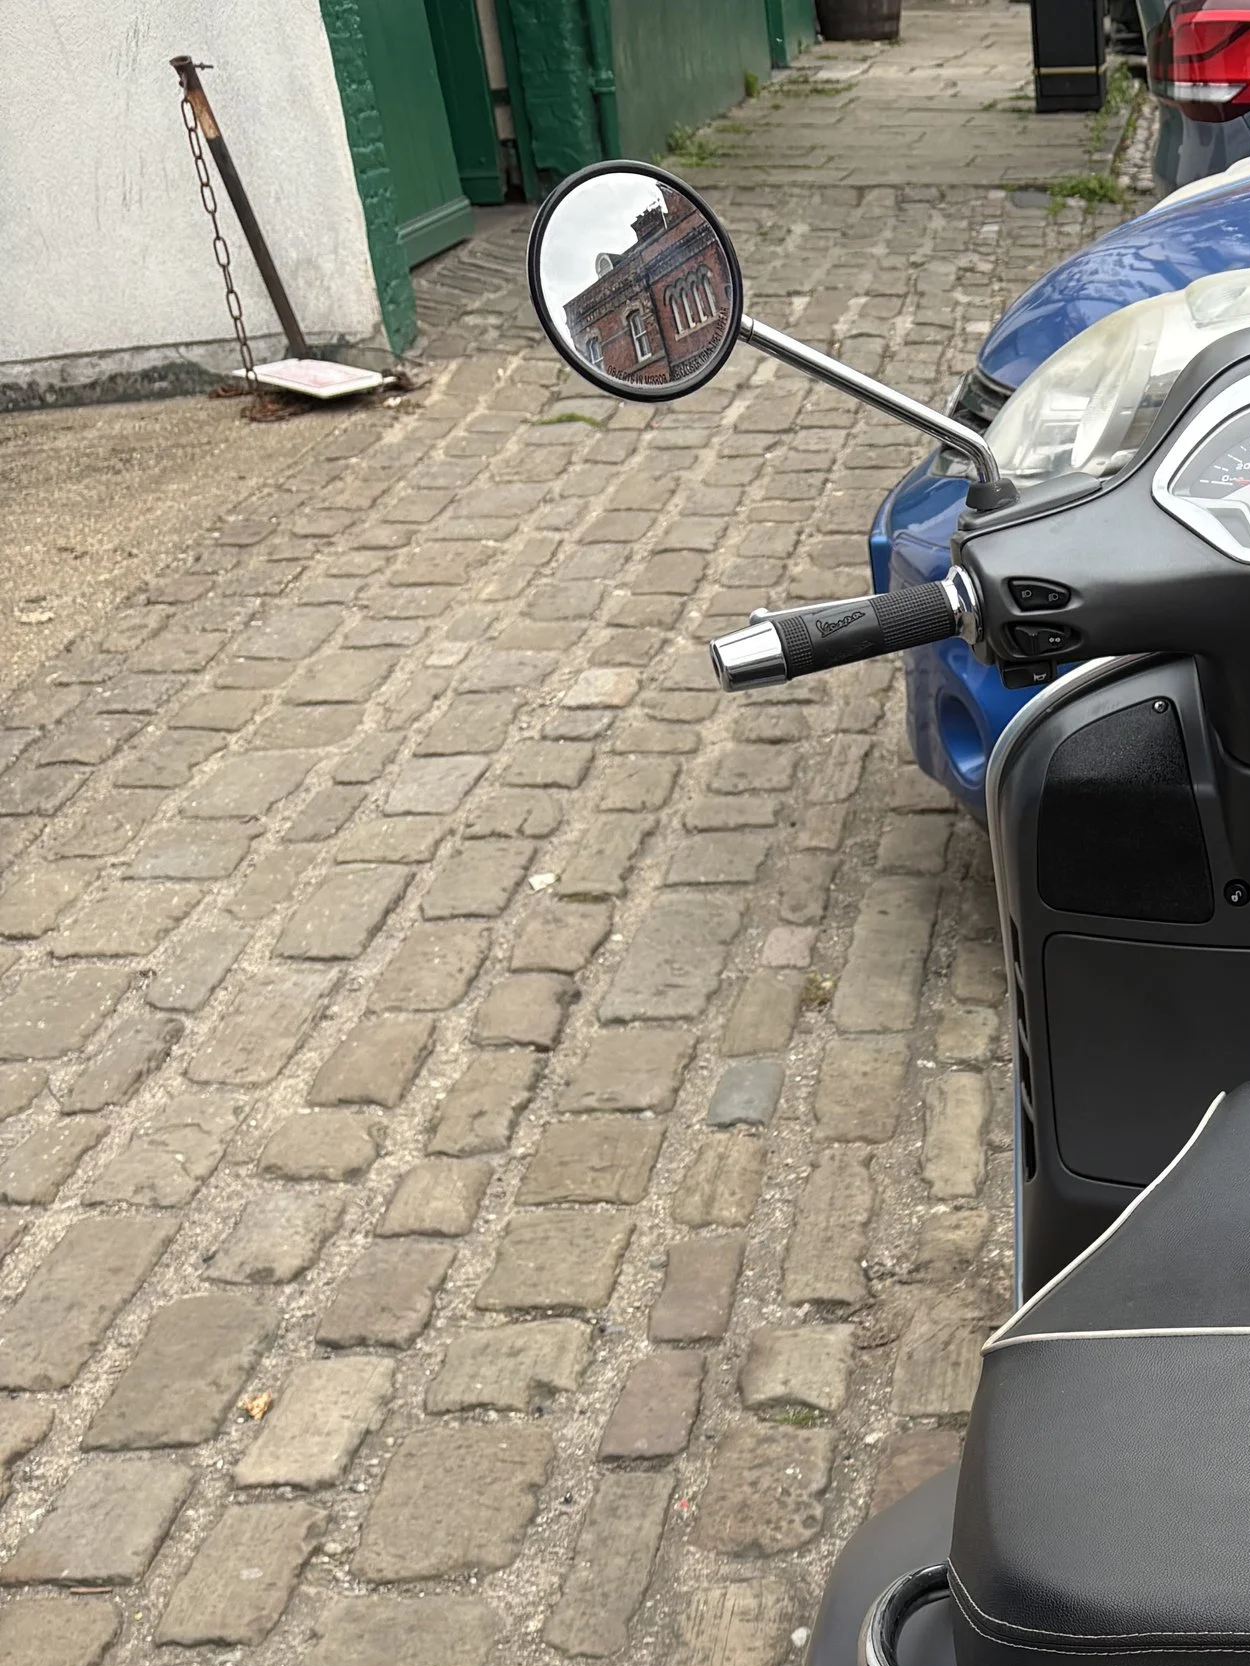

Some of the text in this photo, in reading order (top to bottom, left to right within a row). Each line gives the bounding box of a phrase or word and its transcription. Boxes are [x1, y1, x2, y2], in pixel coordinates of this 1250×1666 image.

[607, 365, 635, 384] OBJECTS
[645, 374, 667, 385] MIRROR
[816, 611, 866, 638] Vespa
